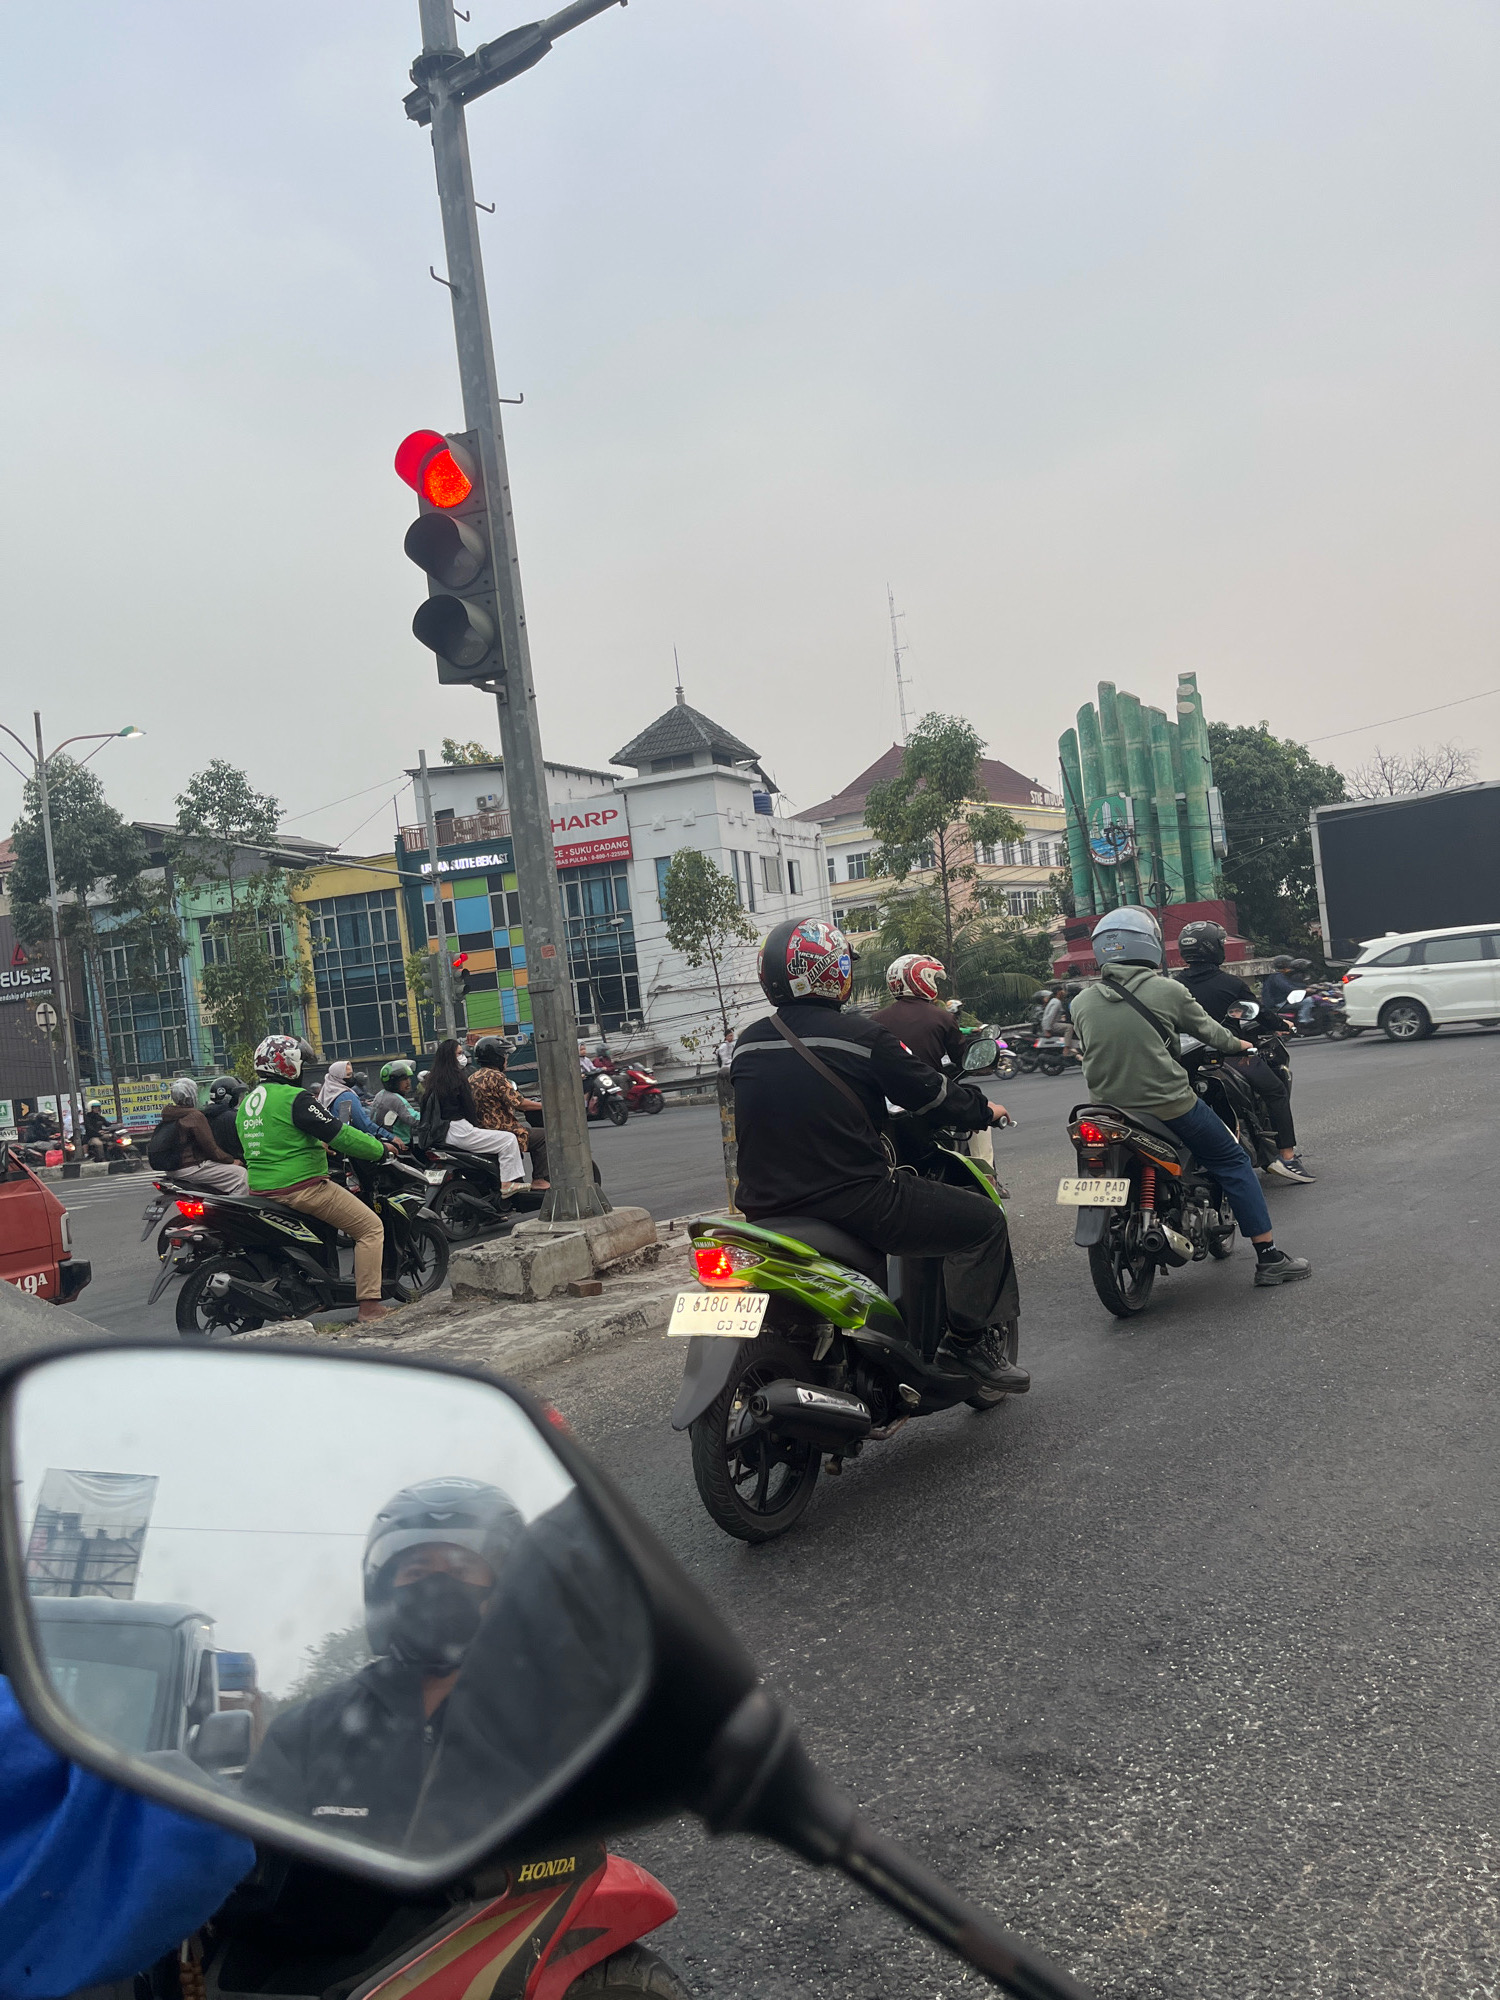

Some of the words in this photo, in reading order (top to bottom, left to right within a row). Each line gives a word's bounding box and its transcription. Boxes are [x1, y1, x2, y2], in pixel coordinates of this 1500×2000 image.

[550, 809, 618, 833] HARP
[569, 845, 592, 856] SUKU
[593, 840, 629, 852] CADANG
[421, 860, 450, 874] URAN
[475, 853, 509, 867] BEKASI
[0, 966, 52, 988] EUSER
[243, 1117, 264, 1130] gojek
[307, 1104, 333, 1124] gopay
[1062, 1181, 1069, 1191] G
[1074, 1181, 1100, 1192] 4017
[1104, 1182, 1126, 1192] PAD
[694, 1240, 716, 1248] YAMAHA
[676, 1296, 686, 1314] B
[693, 1295, 730, 1313] 6180
[734, 1296, 767, 1314] KUX
[518, 1856, 576, 1882] HONDA
